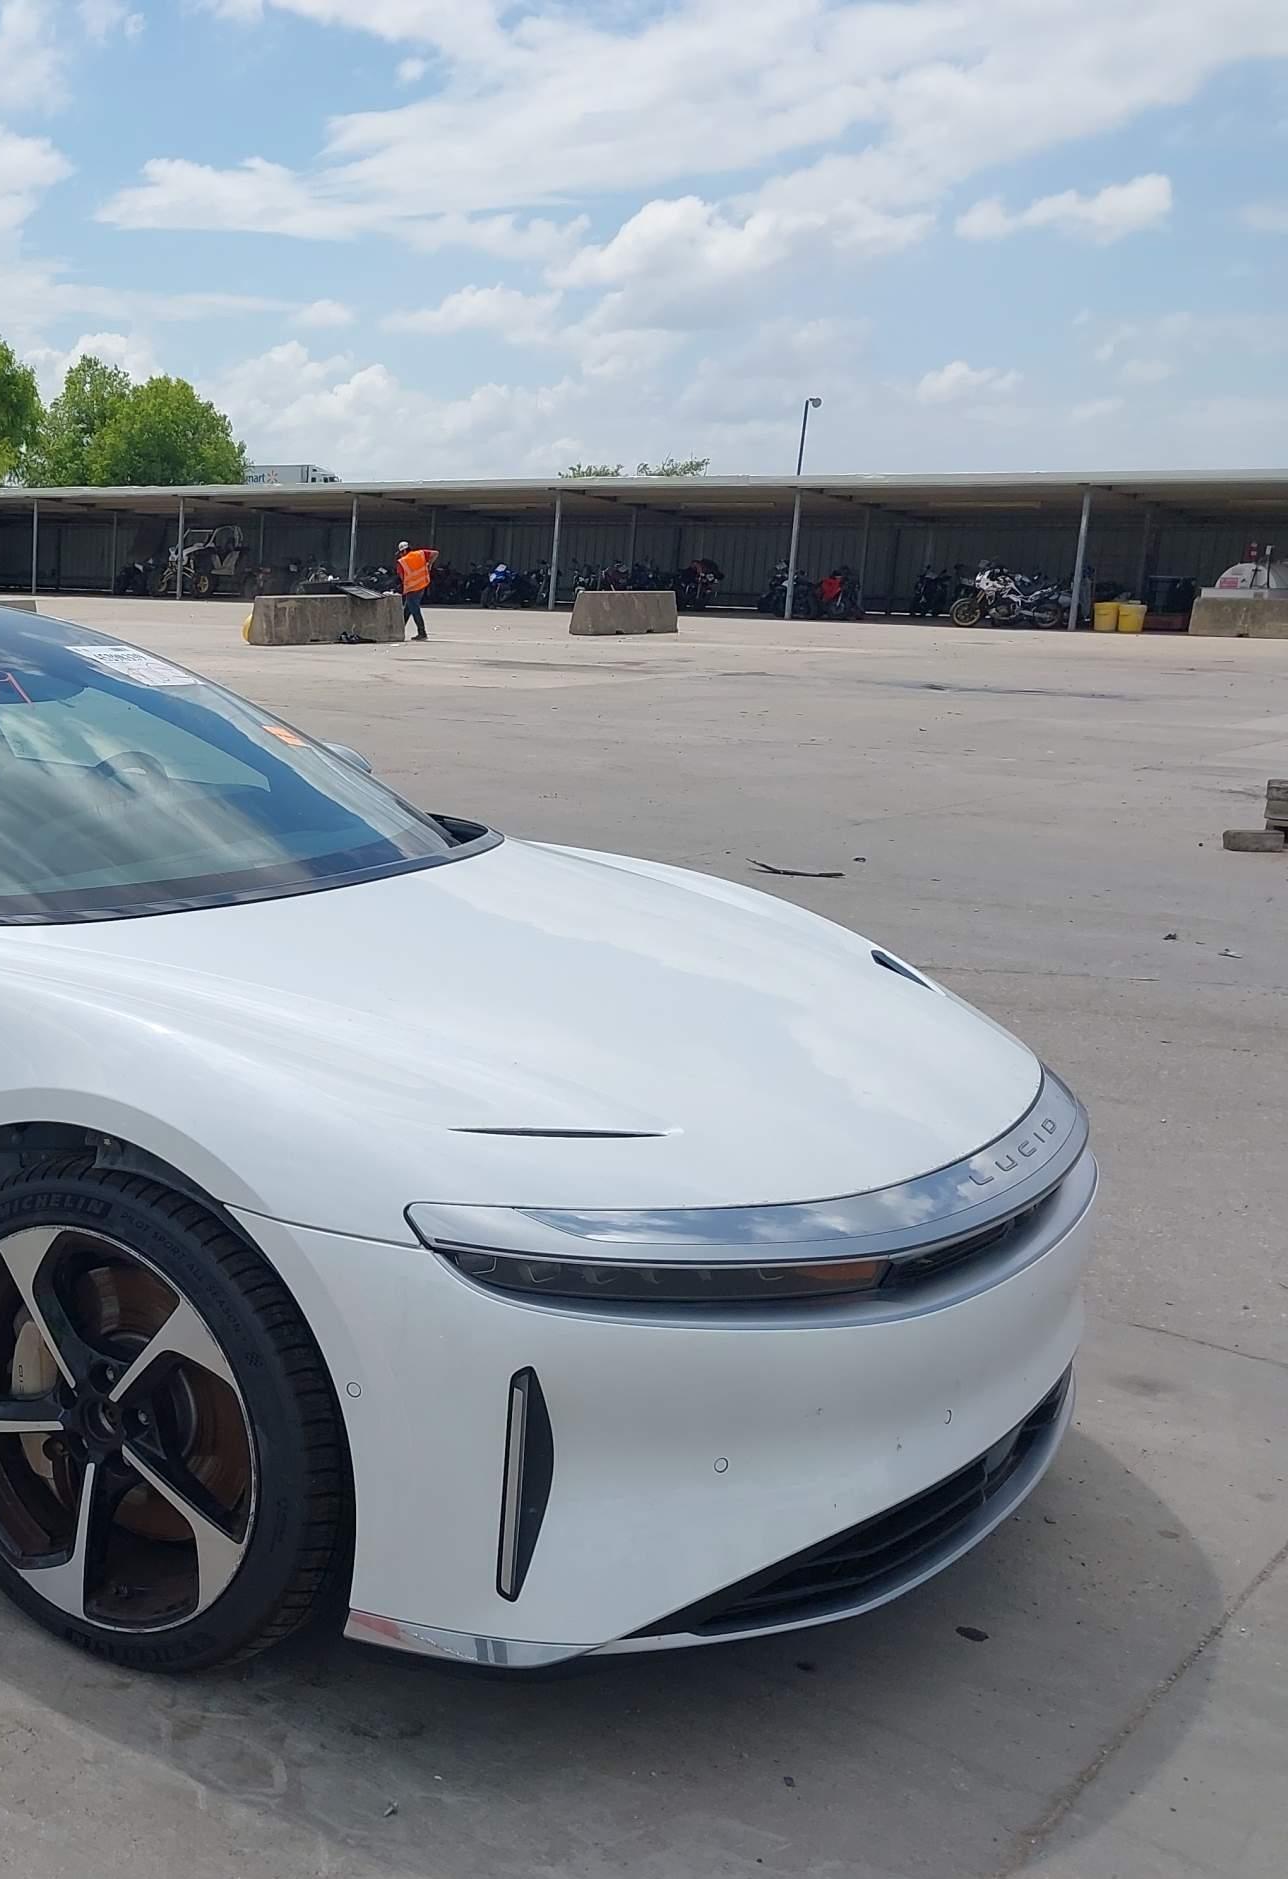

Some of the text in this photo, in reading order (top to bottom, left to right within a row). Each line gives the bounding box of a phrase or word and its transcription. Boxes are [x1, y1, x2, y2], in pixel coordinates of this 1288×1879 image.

[968, 1118, 1056, 1186] LUCID
[152, 1231, 188, 1259] SPORT
[186, 1263, 202, 1281] ALL
